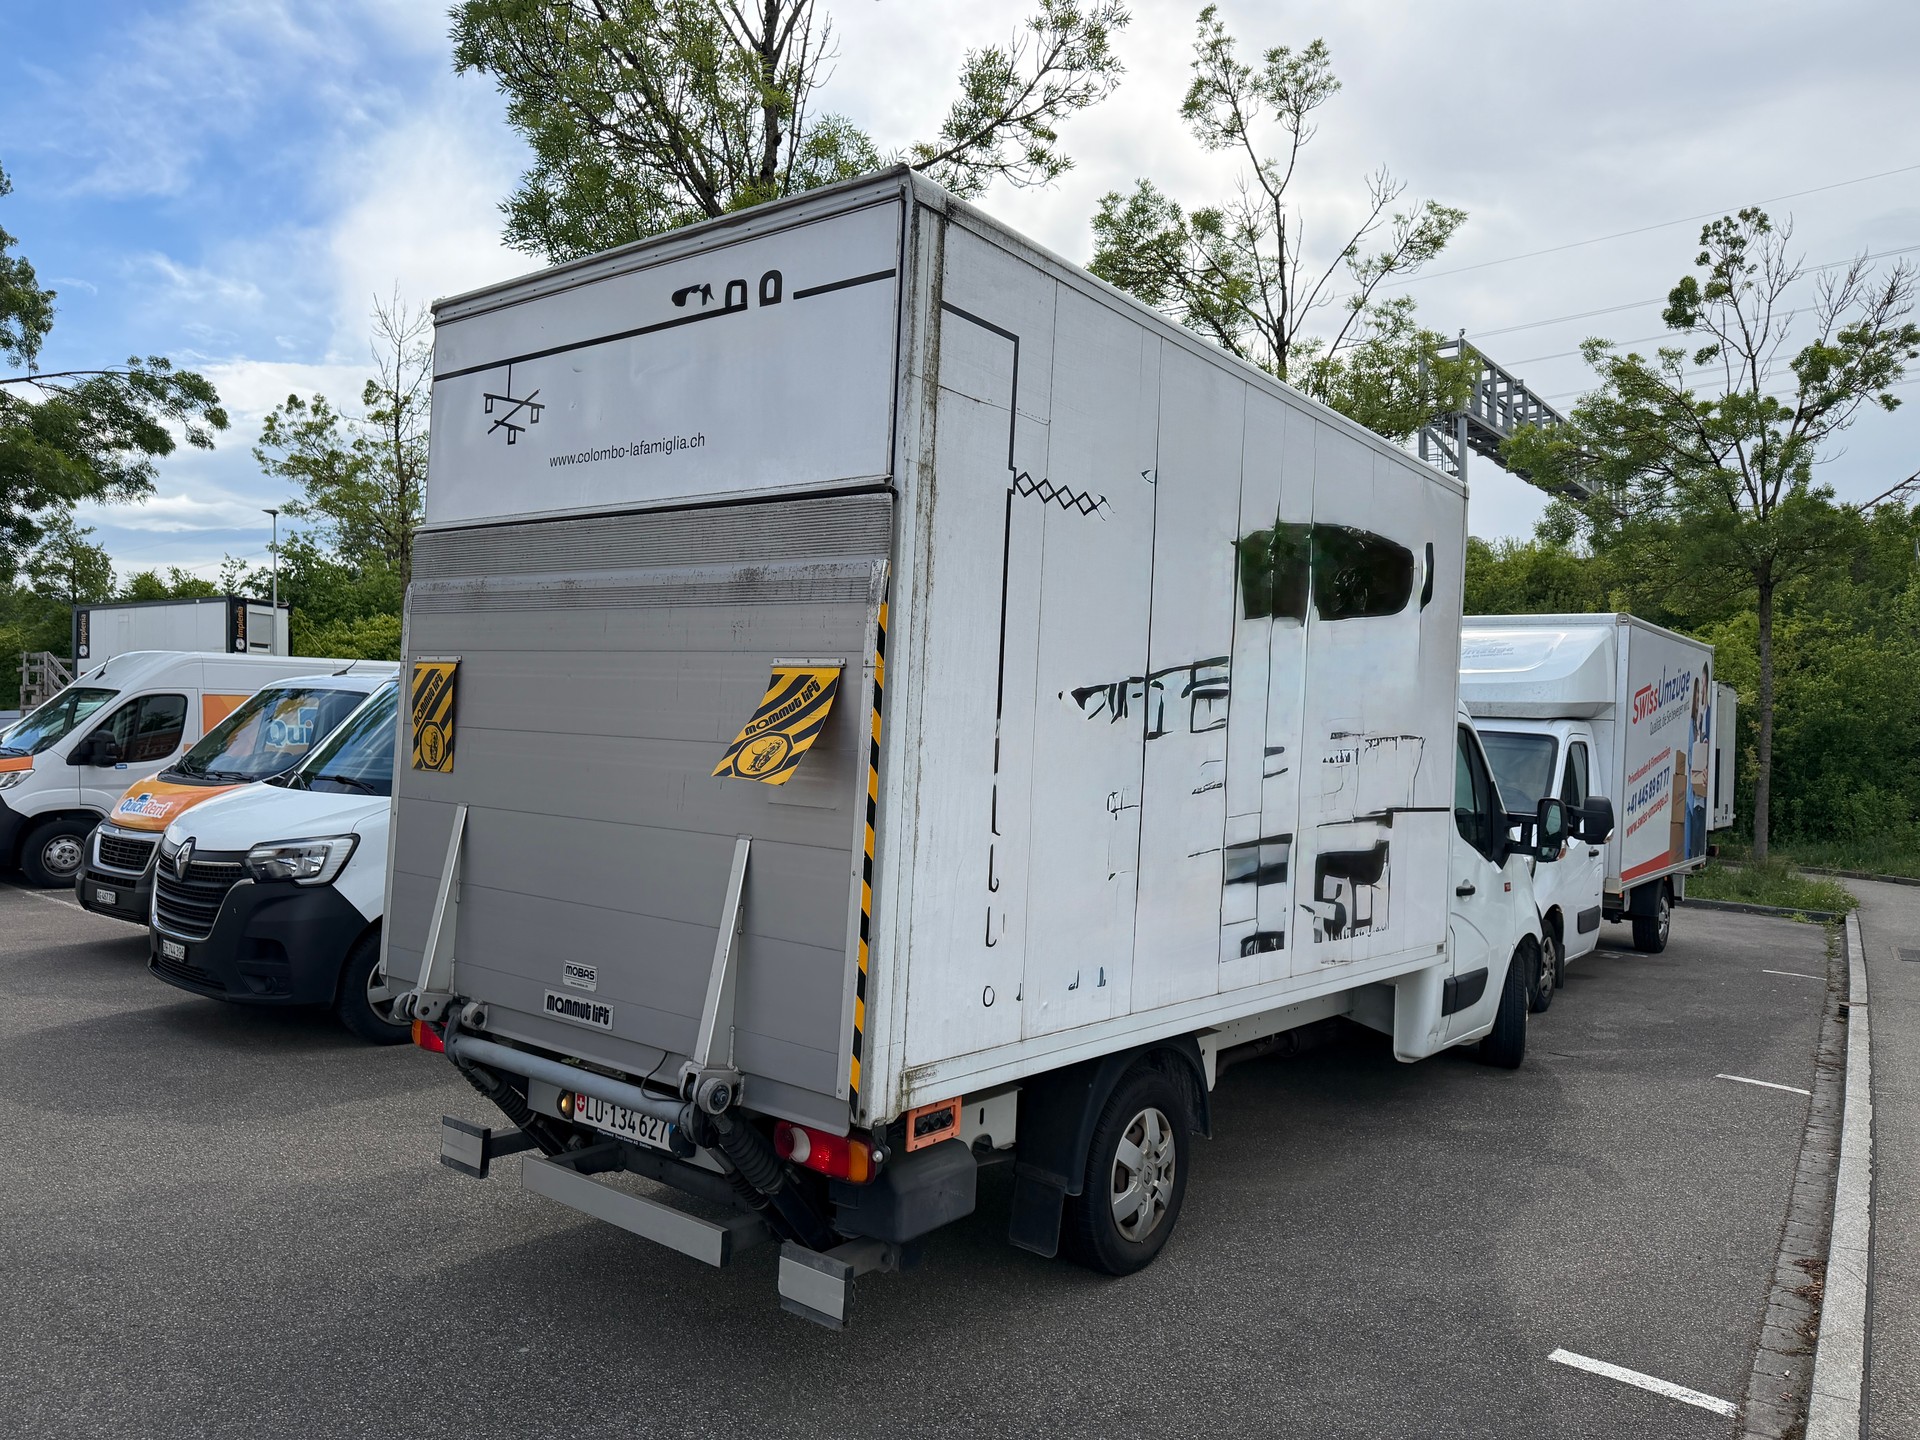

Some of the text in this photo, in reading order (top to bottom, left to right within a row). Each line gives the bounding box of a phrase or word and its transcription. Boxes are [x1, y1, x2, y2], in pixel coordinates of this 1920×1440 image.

[549, 432, 705, 467] www.colombo-lafamiglia.ch
[79, 613, 87, 645] Implenia
[236, 606, 244, 638] Implenia
[745, 679, 821, 736] mammut lift
[119, 797, 172, 818] QuickRent
[565, 964, 595, 980] MOBAS
[546, 994, 609, 1026] mammut lift
